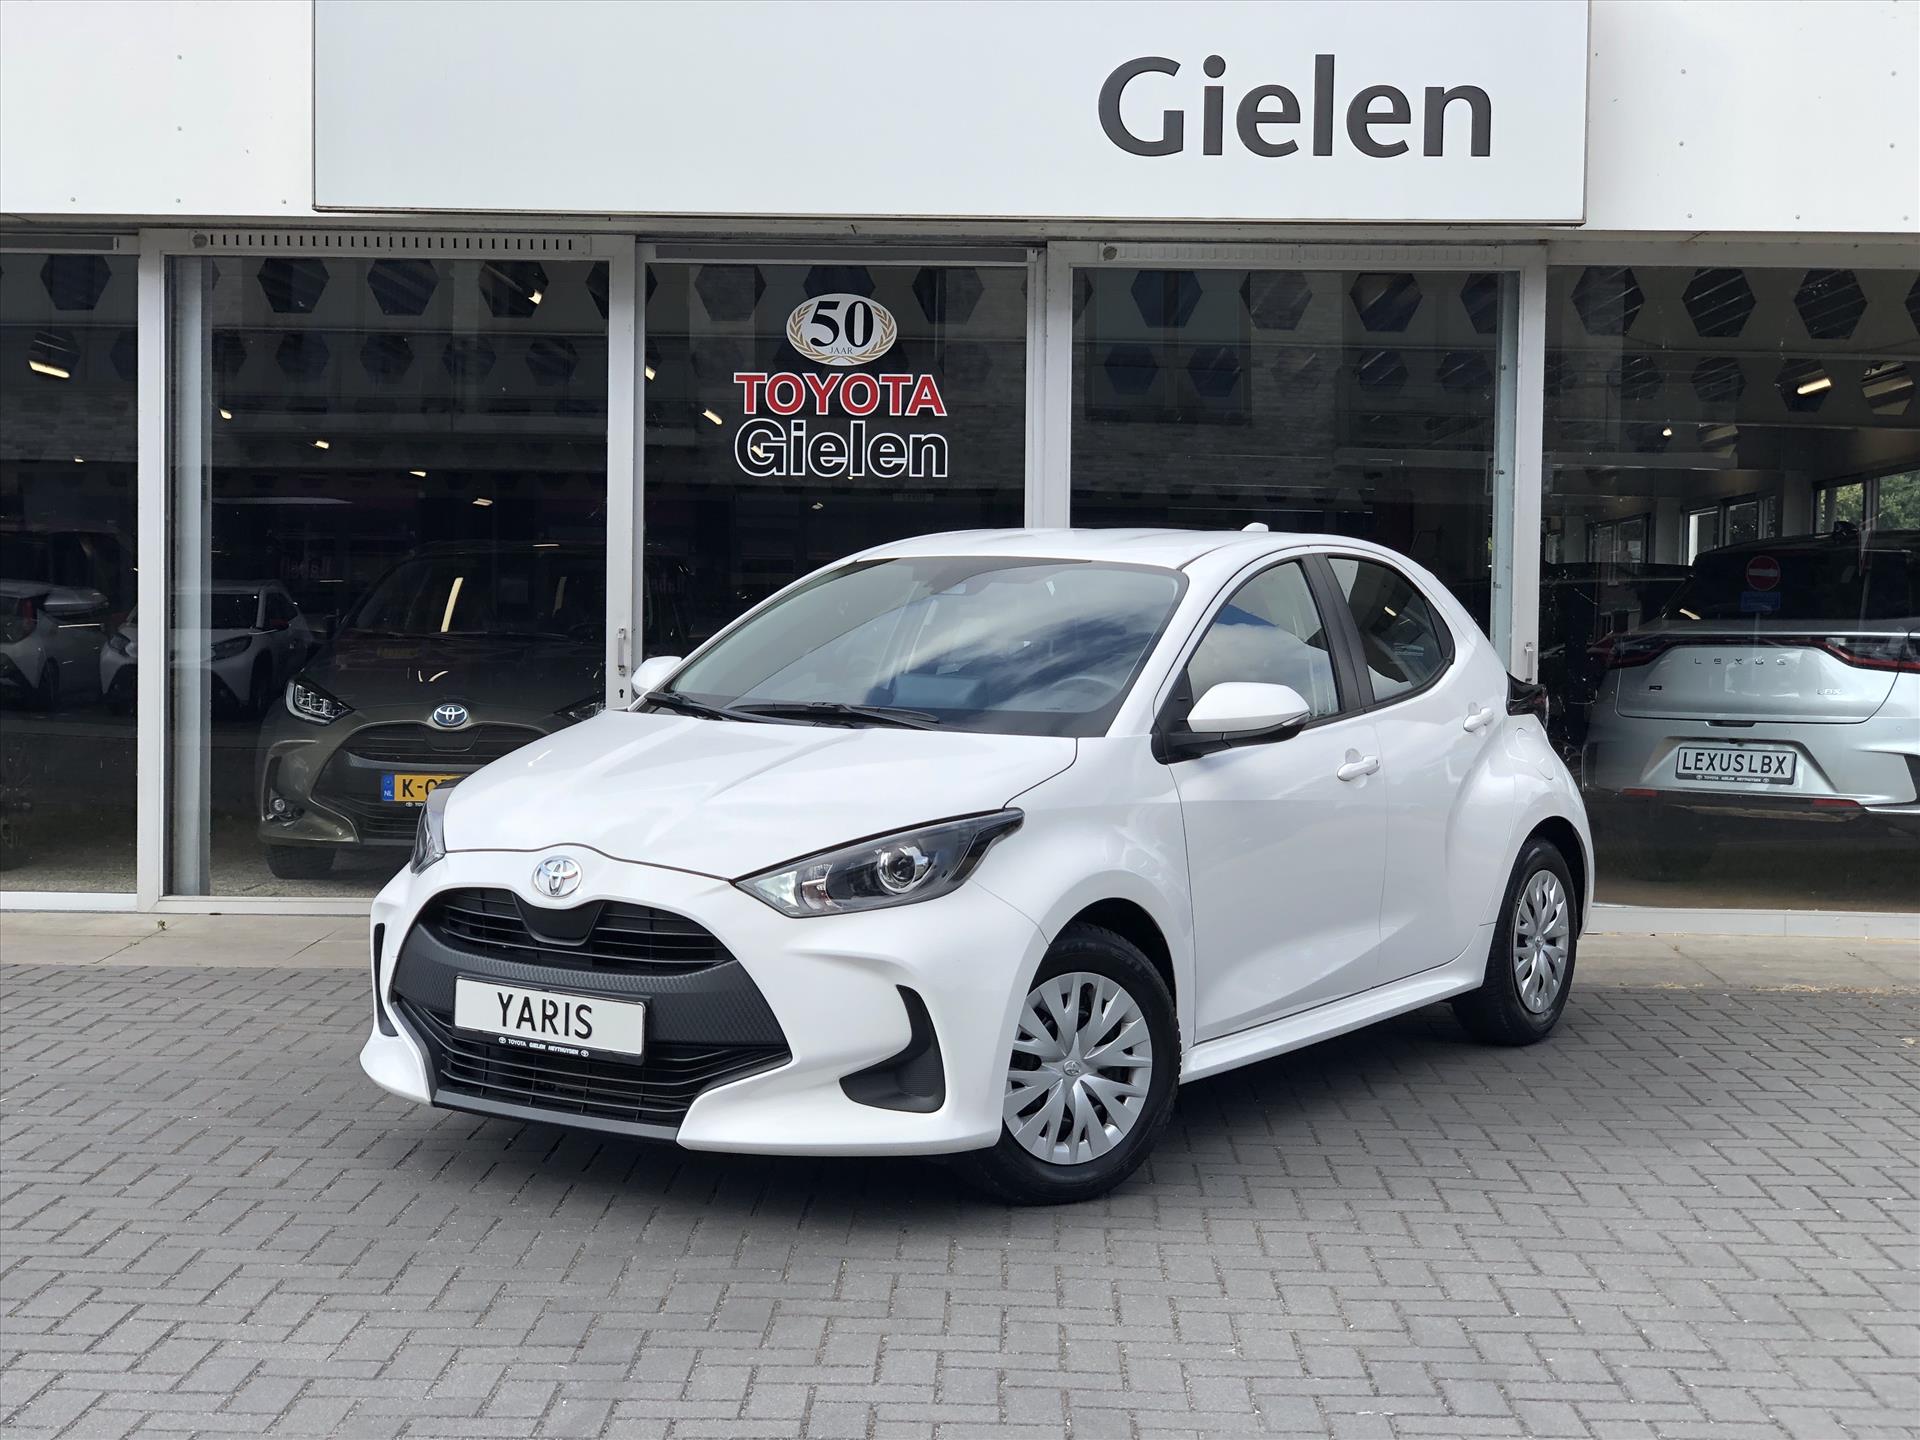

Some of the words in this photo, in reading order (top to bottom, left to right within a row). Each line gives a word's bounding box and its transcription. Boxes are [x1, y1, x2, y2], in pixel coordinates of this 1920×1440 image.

[1098, 54, 1492, 158] Gielen
[810, 300, 874, 347] 50
[829, 347, 853, 355] JAAR
[734, 372, 947, 416] TOYOTA
[735, 418, 948, 478] Gielen
[1694, 657, 1786, 665] LEXUS
[497, 992, 593, 1039] YARIS
[508, 1038, 527, 1047] TOYOTA
